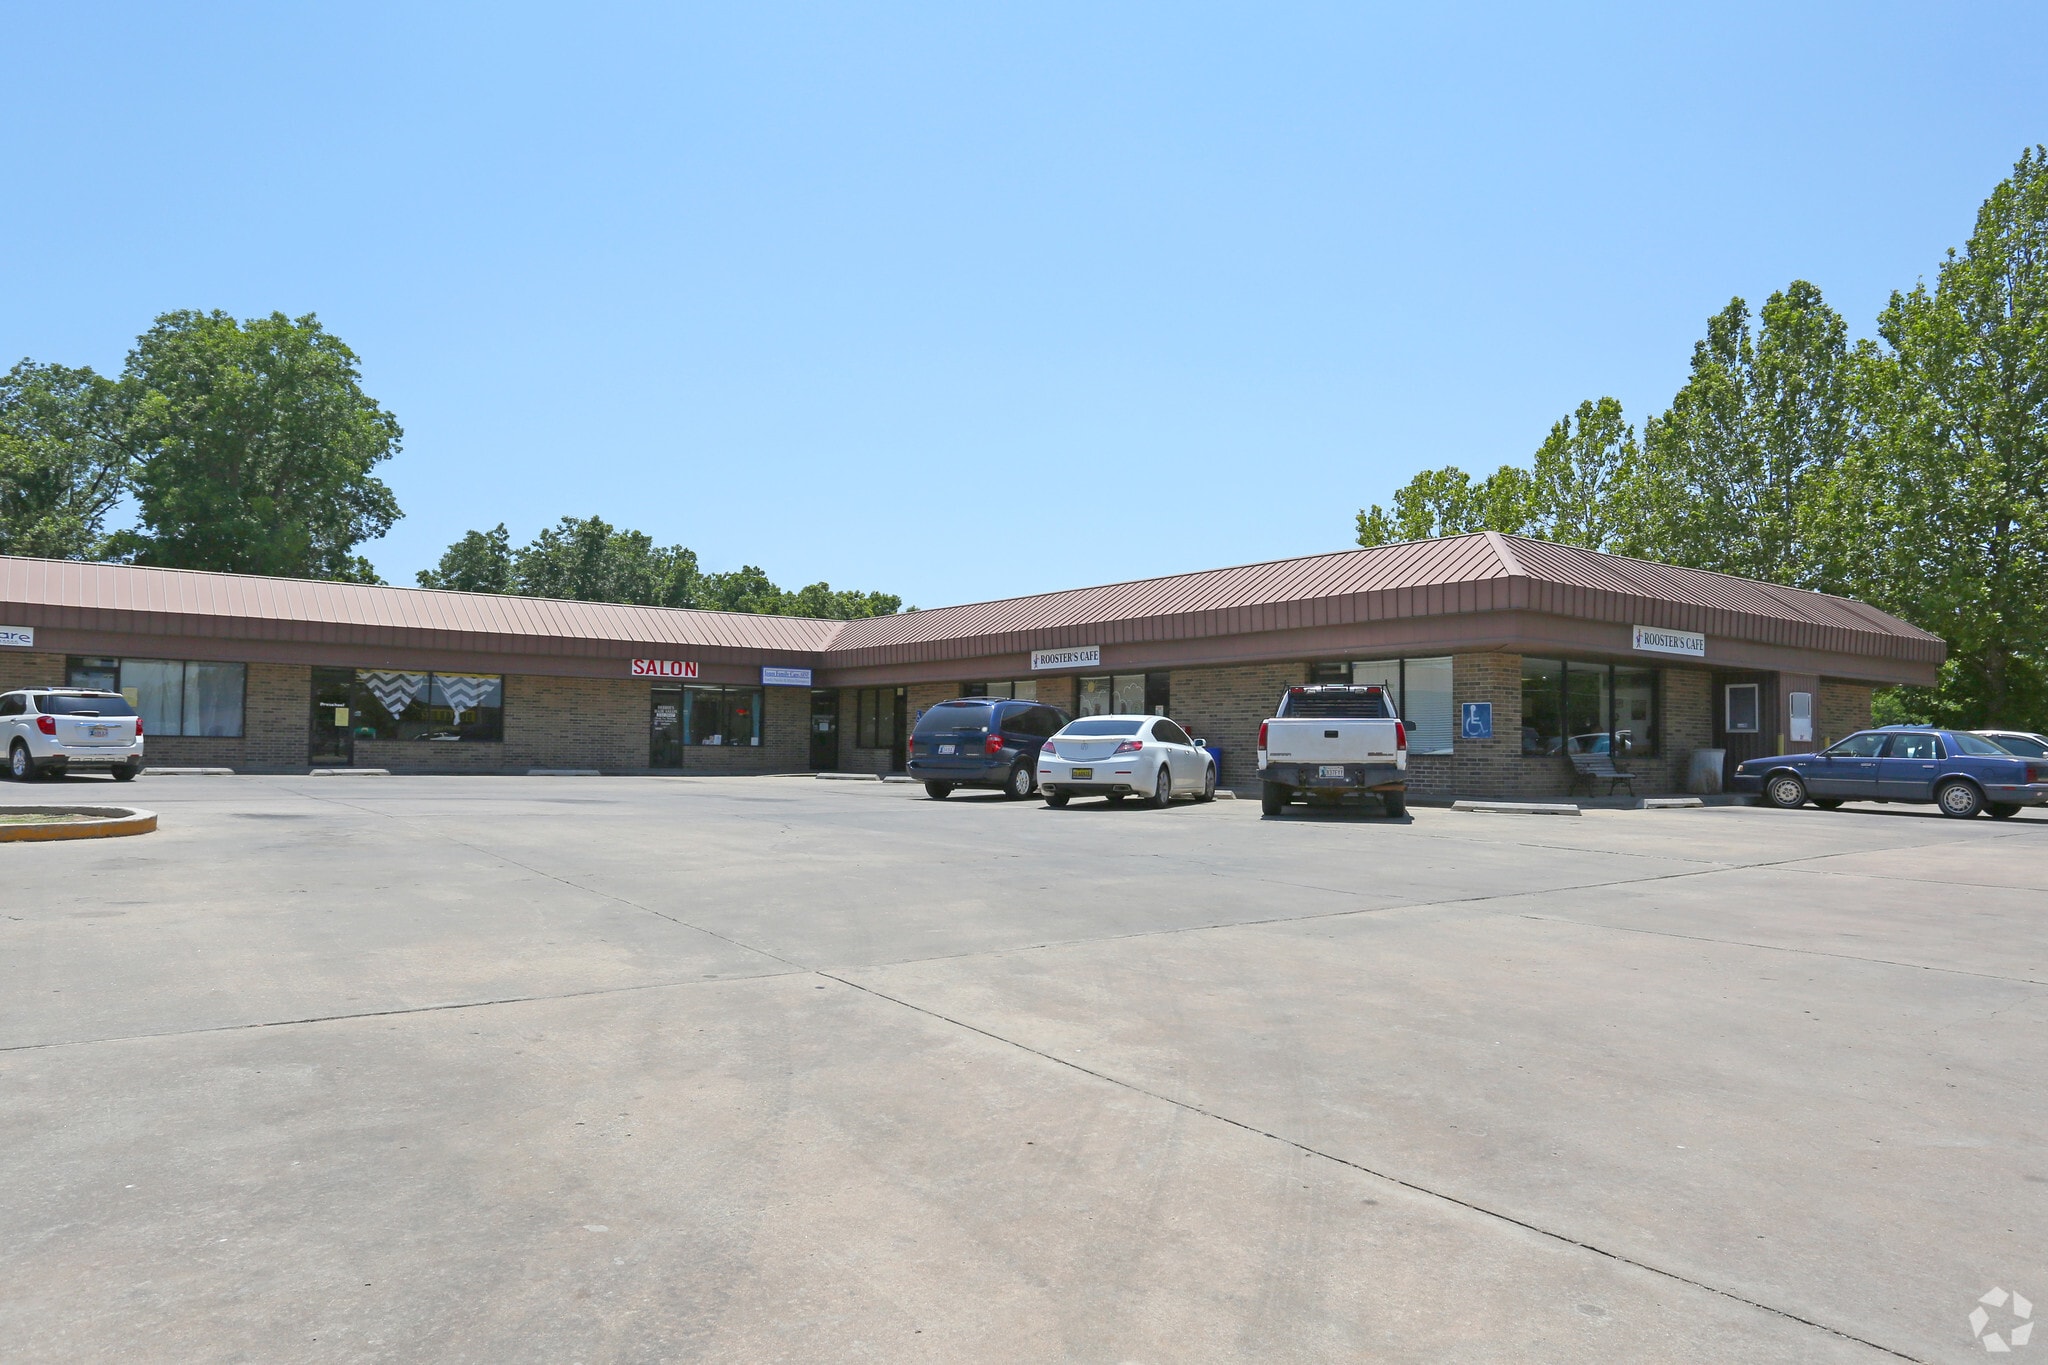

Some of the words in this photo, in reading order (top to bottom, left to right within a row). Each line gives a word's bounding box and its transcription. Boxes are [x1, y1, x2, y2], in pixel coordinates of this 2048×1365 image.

[1644, 632, 1685, 649] ROOSTER'S
[1686, 637, 1704, 651] CAFE
[1040, 652, 1079, 665] ROOSTER'S
[1080, 650, 1099, 661] CAFE
[633, 659, 697, 677] SALON
